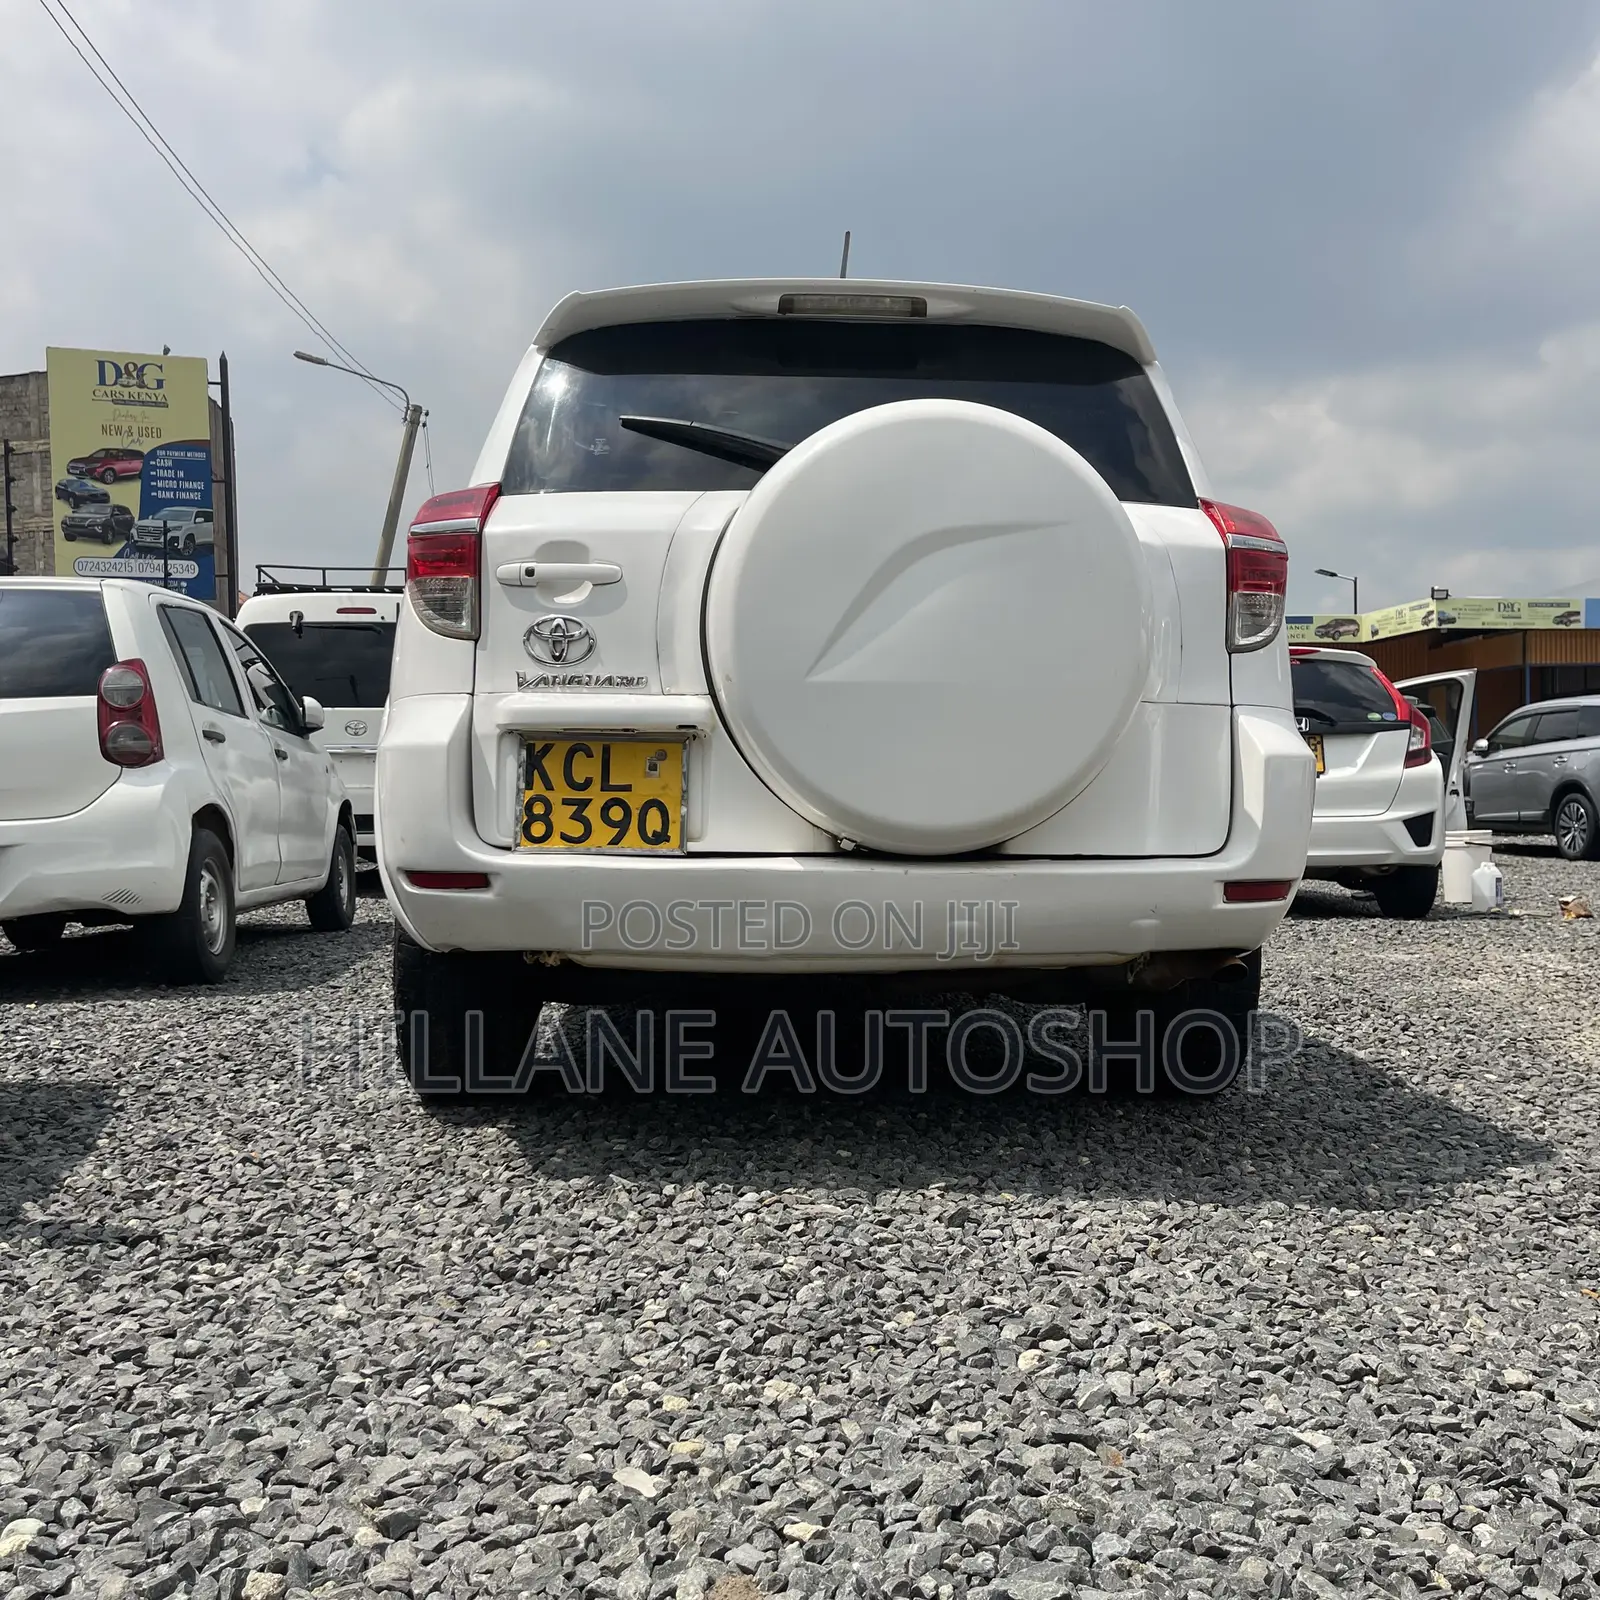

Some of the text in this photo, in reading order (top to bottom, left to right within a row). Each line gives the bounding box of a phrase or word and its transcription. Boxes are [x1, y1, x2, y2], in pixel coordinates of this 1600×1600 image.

[95, 360, 166, 390] D&G
[92, 388, 168, 402] CARS KENYA
[101, 424, 162, 439] NEW & USED
[156, 458, 173, 467] CASH
[156, 469, 184, 478] TRADE IN
[157, 480, 205, 490] MICRO FINANCE
[157, 490, 201, 500] BANK FINANCE
[77, 561, 133, 573] 0724324215
[515, 670, 649, 692] VANGUARD
[525, 742, 633, 793] KCL
[521, 794, 672, 847] 839Q
